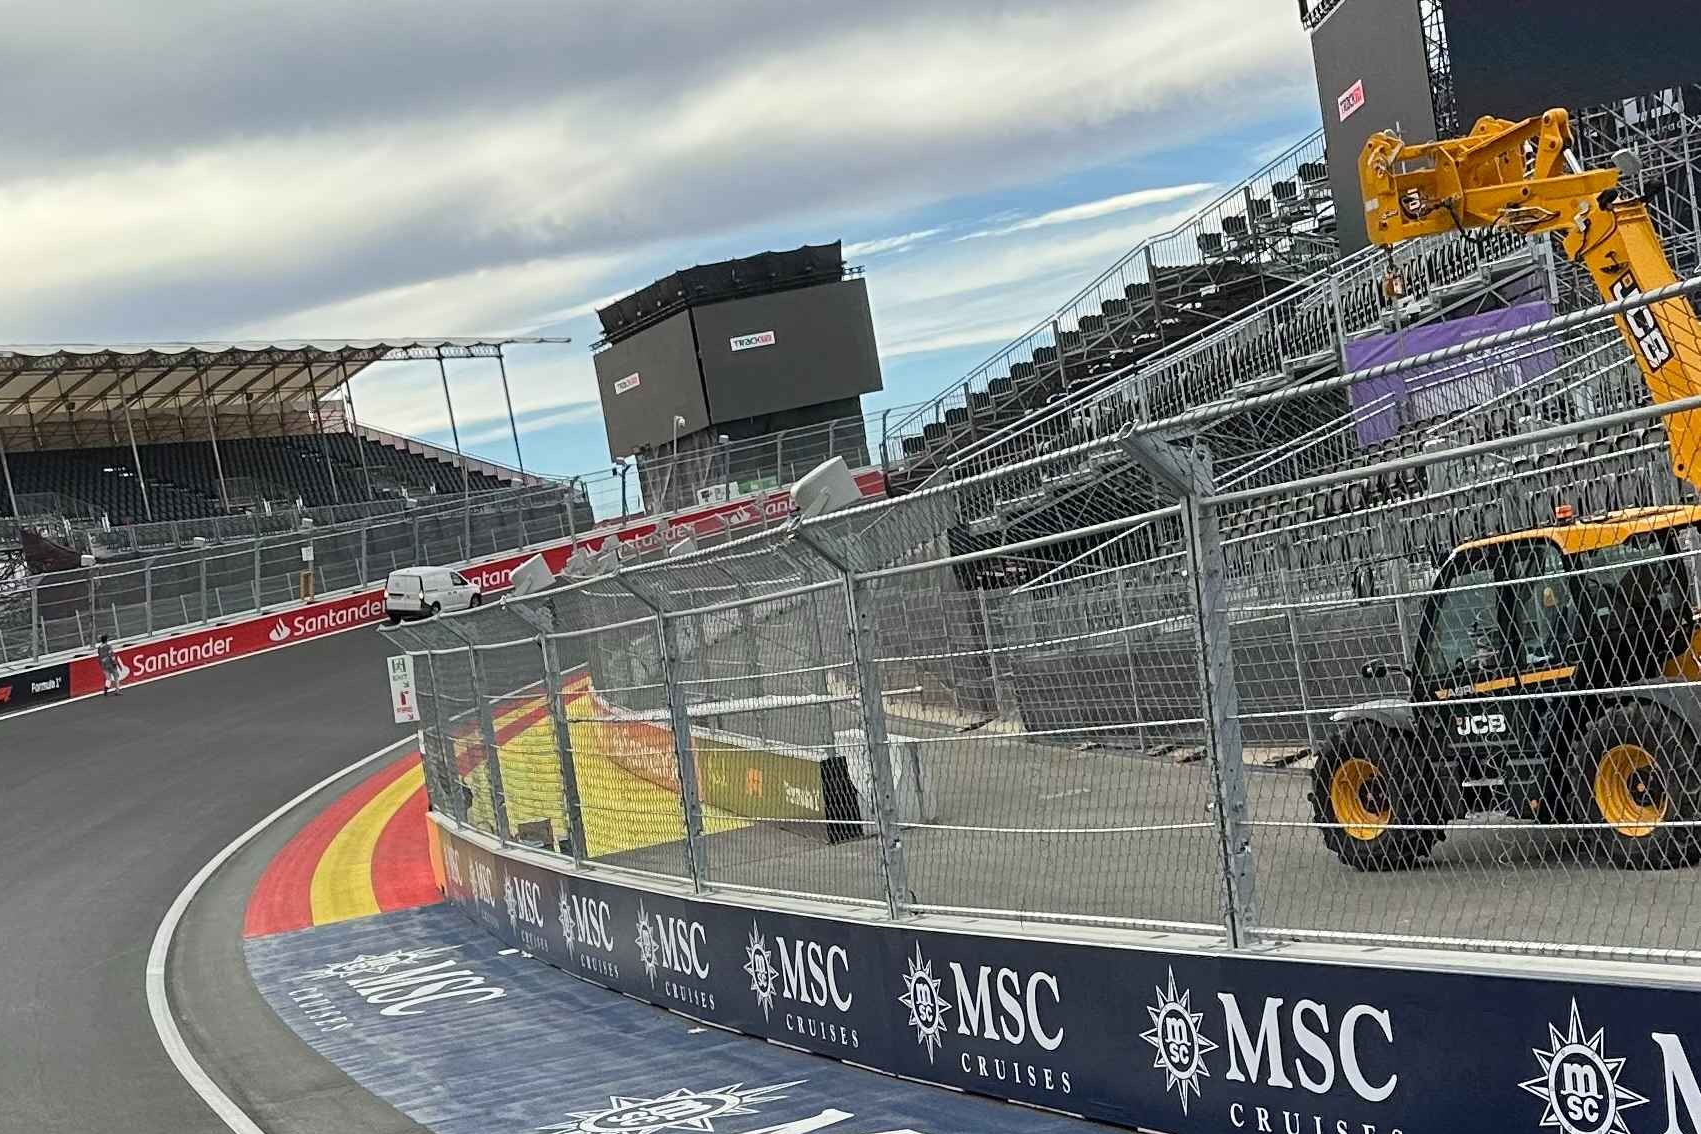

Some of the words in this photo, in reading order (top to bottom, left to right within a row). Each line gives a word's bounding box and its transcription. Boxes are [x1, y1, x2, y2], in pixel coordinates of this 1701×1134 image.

[294, 600, 386, 637] Santander
[133, 636, 234, 677] Santander
[31, 680, 54, 694] Formula
[1456, 714, 1506, 735] JCB
[514, 876, 544, 928] MSC
[572, 894, 613, 951] MSC
[656, 914, 709, 979] MSC
[346, 959, 507, 1016] MSC
[665, 981, 715, 1010] CRUISES
[776, 937, 853, 1012] MSC
[949, 961, 1064, 1051] MSC
[787, 1014, 859, 1048] CRUISES
[1217, 992, 1397, 1101] MSC
[962, 1052, 1071, 1094] CRUISES
